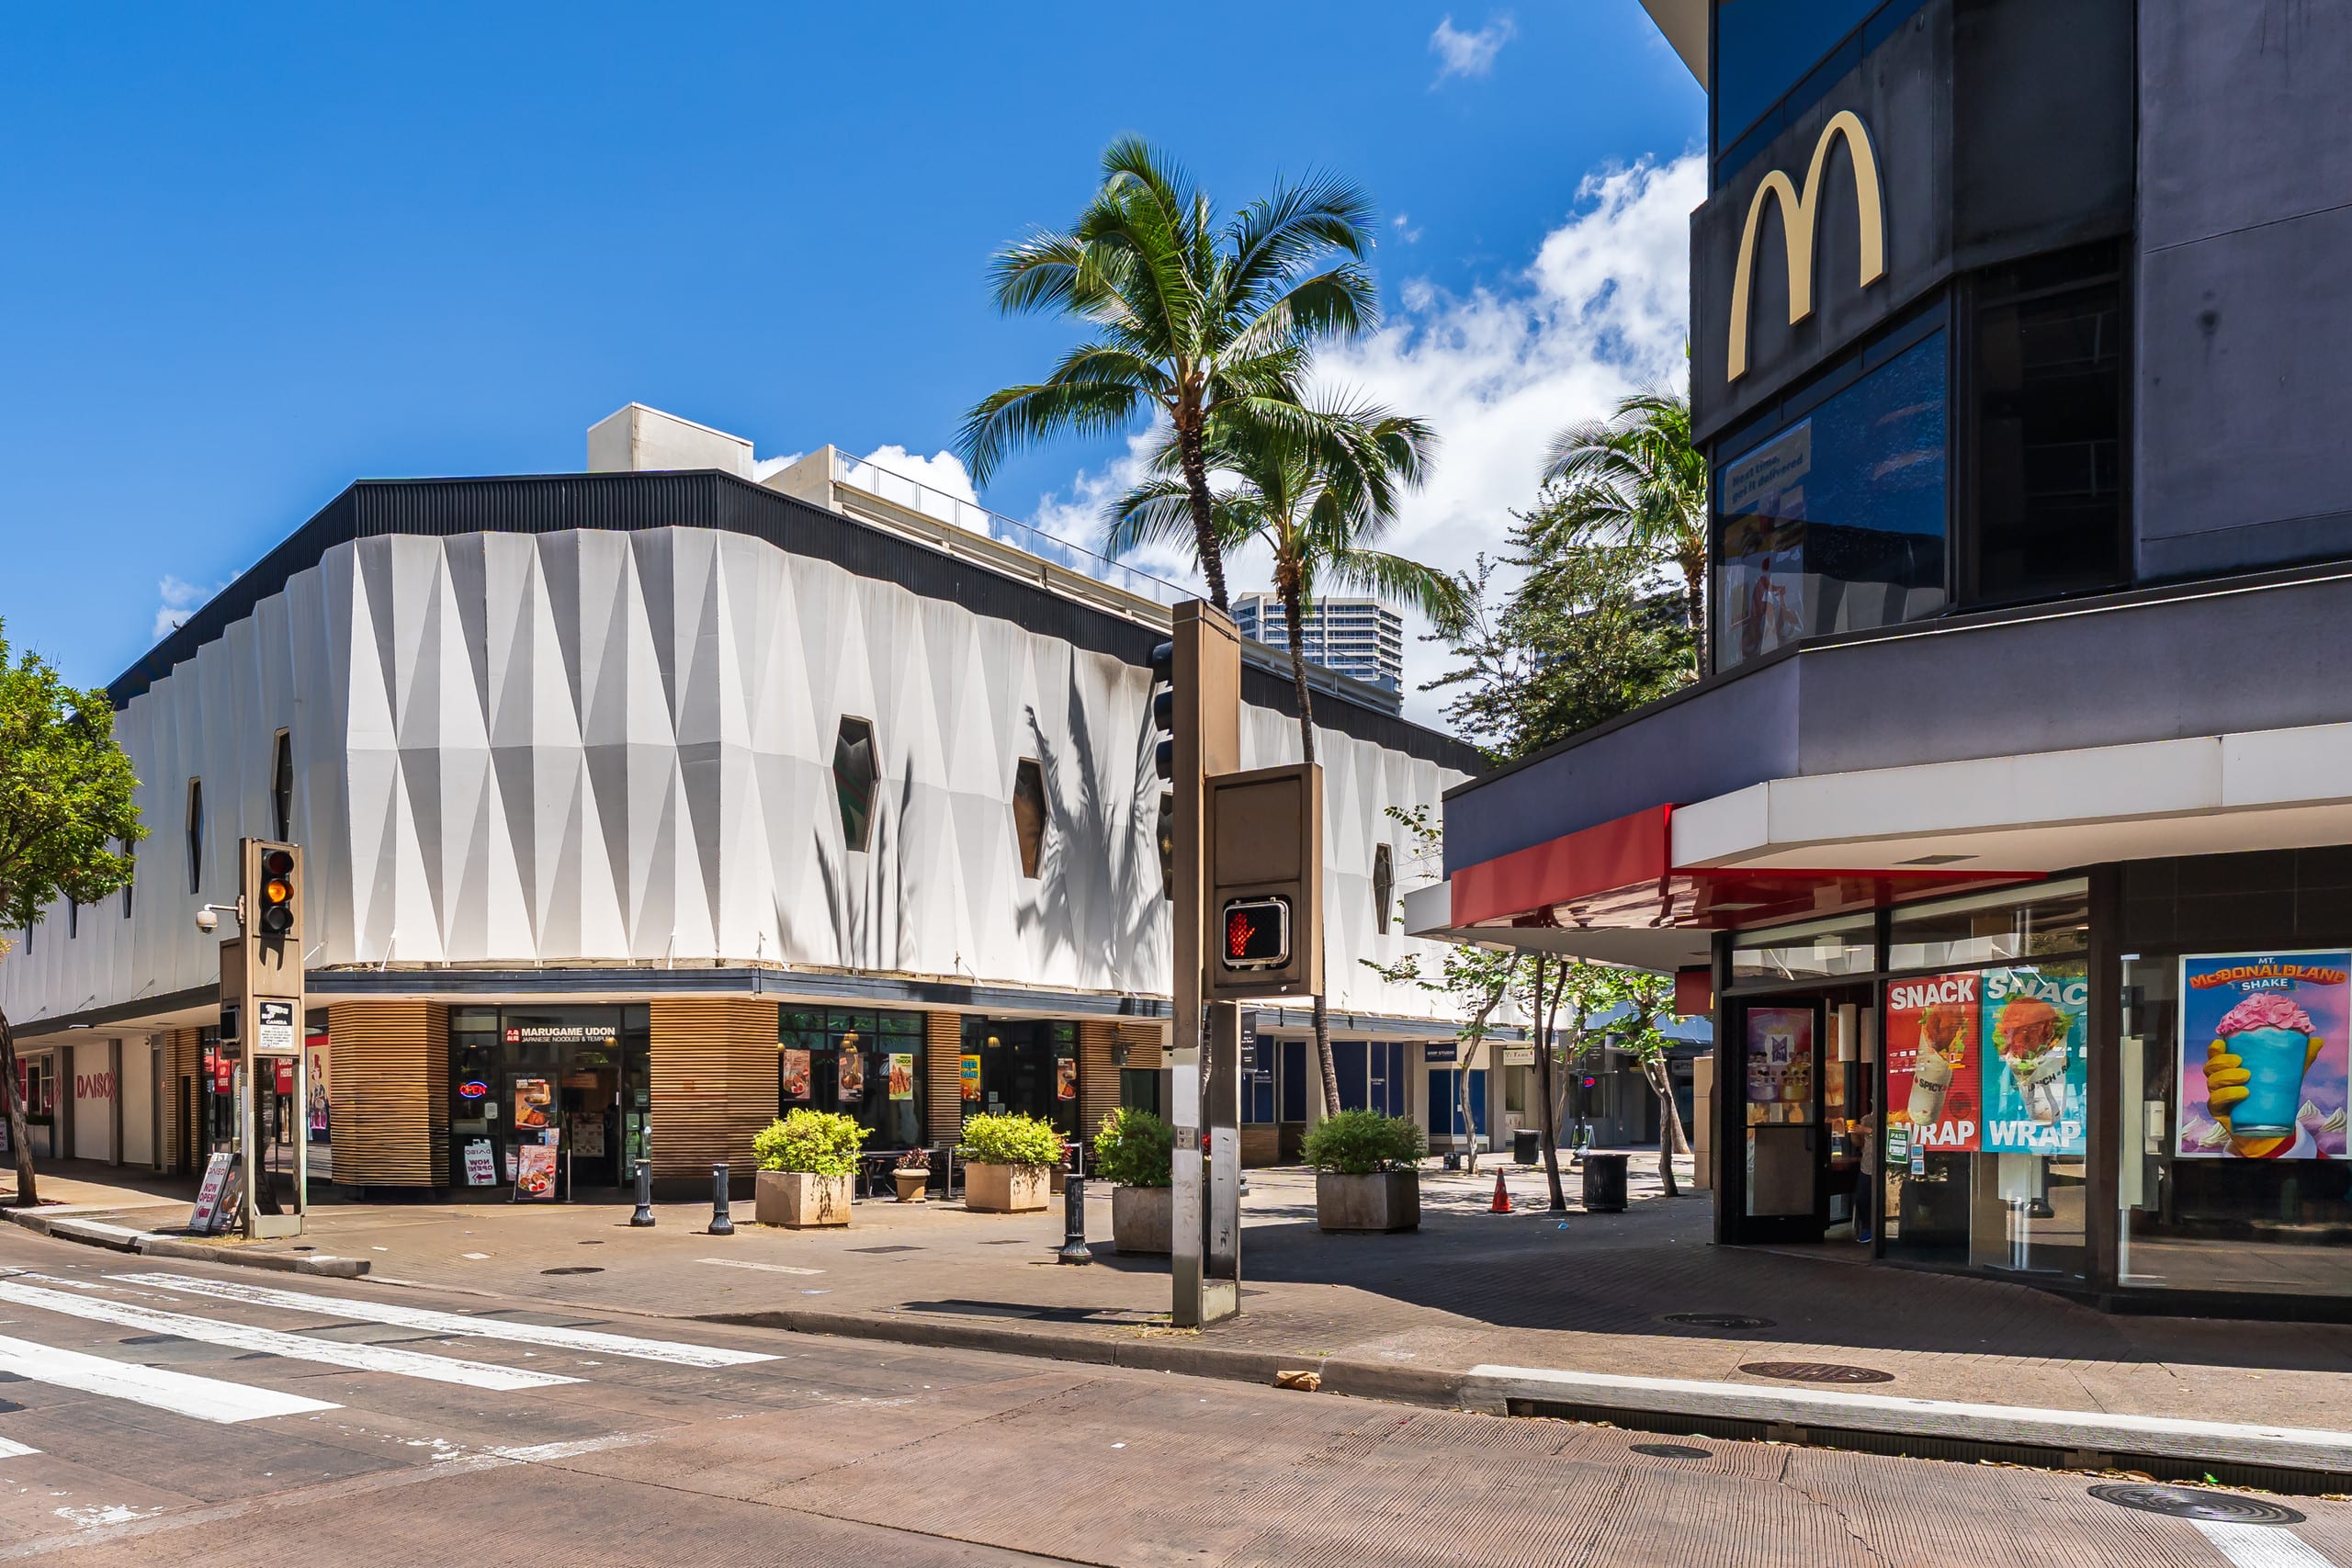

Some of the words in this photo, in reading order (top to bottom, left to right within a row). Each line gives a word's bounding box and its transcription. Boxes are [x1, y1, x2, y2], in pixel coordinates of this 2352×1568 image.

[1732, 468, 1754, 487] Next
[1756, 456, 1781, 473] time,
[1732, 487, 1747, 504] get
[1758, 452, 1804, 488] delivered
[1891, 978, 1974, 1010] SNACK
[1987, 976, 2087, 1006] SNAC
[2242, 978, 2289, 991] SHAKE
[521, 1028, 583, 1036] MARUGAME
[585, 1027, 616, 1035] UDON
[76, 1072, 111, 1100] DAISO
[459, 1085, 486, 1095] OPEN
[1918, 1077, 1943, 1092] SPICY
[1988, 1120, 2082, 1147] WRAP
[203, 1182, 218, 1193] NOW
